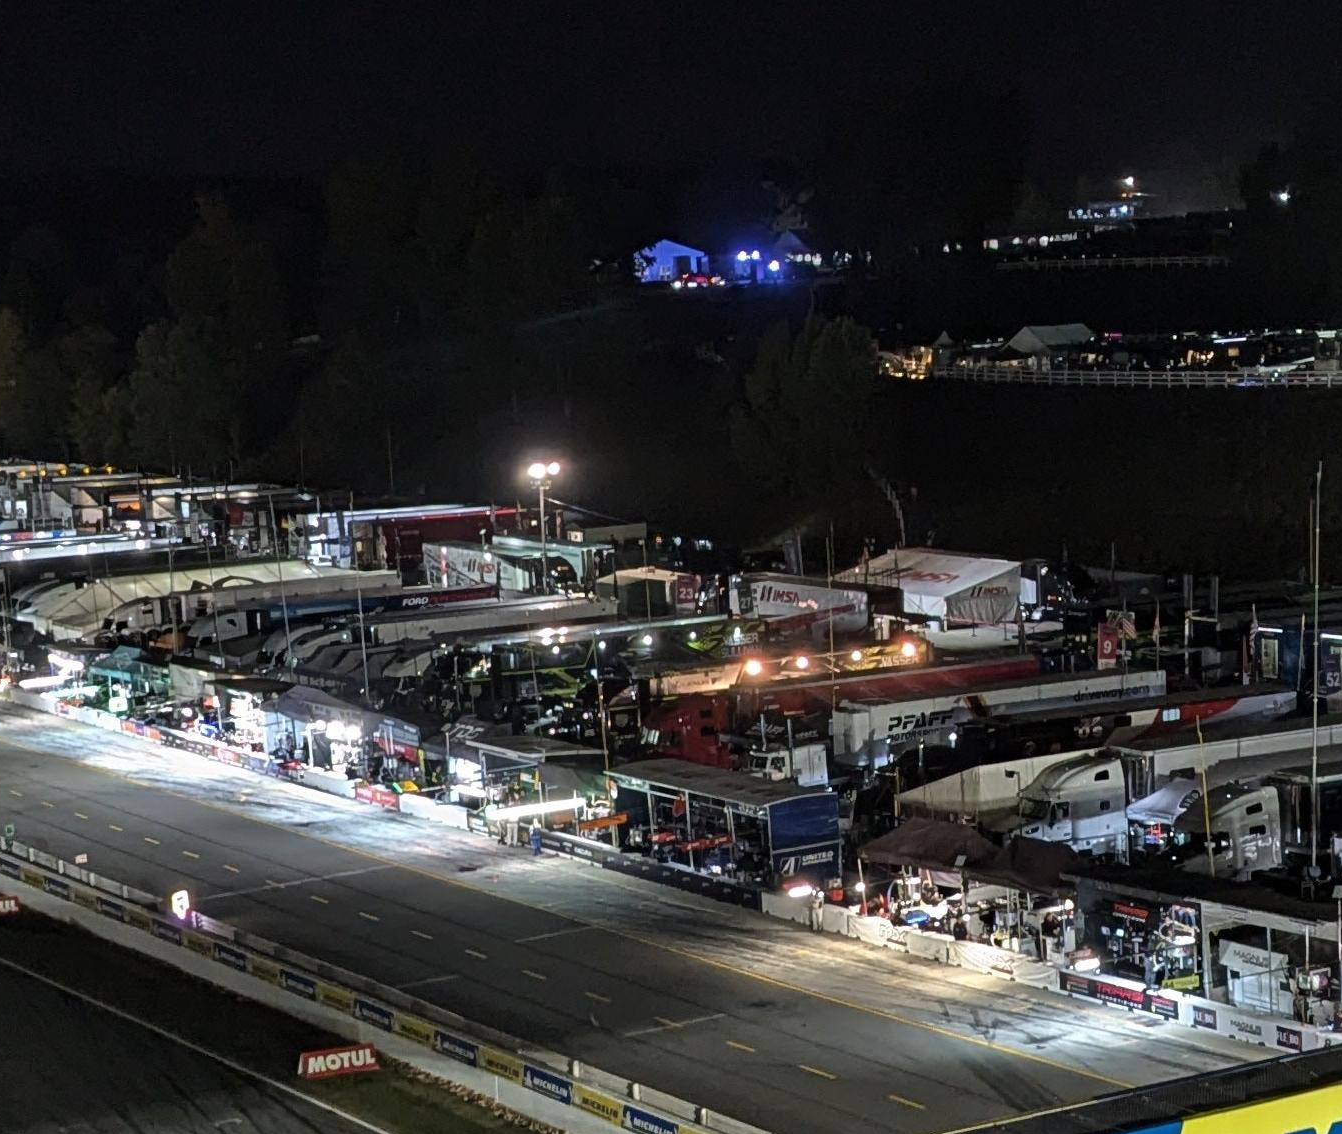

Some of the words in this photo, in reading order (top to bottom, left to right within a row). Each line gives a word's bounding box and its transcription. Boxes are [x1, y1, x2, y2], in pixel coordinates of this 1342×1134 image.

[402, 596, 429, 607] FORD
[679, 587, 694, 600] 23
[1103, 640, 1112, 654] 9
[1327, 671, 1341, 687] 52
[888, 709, 954, 732] PFAFF
[308, 1047, 376, 1074] MOTUL
[532, 1075, 568, 1098] MICHELIN
[582, 1095, 619, 1119] MICHELIN
